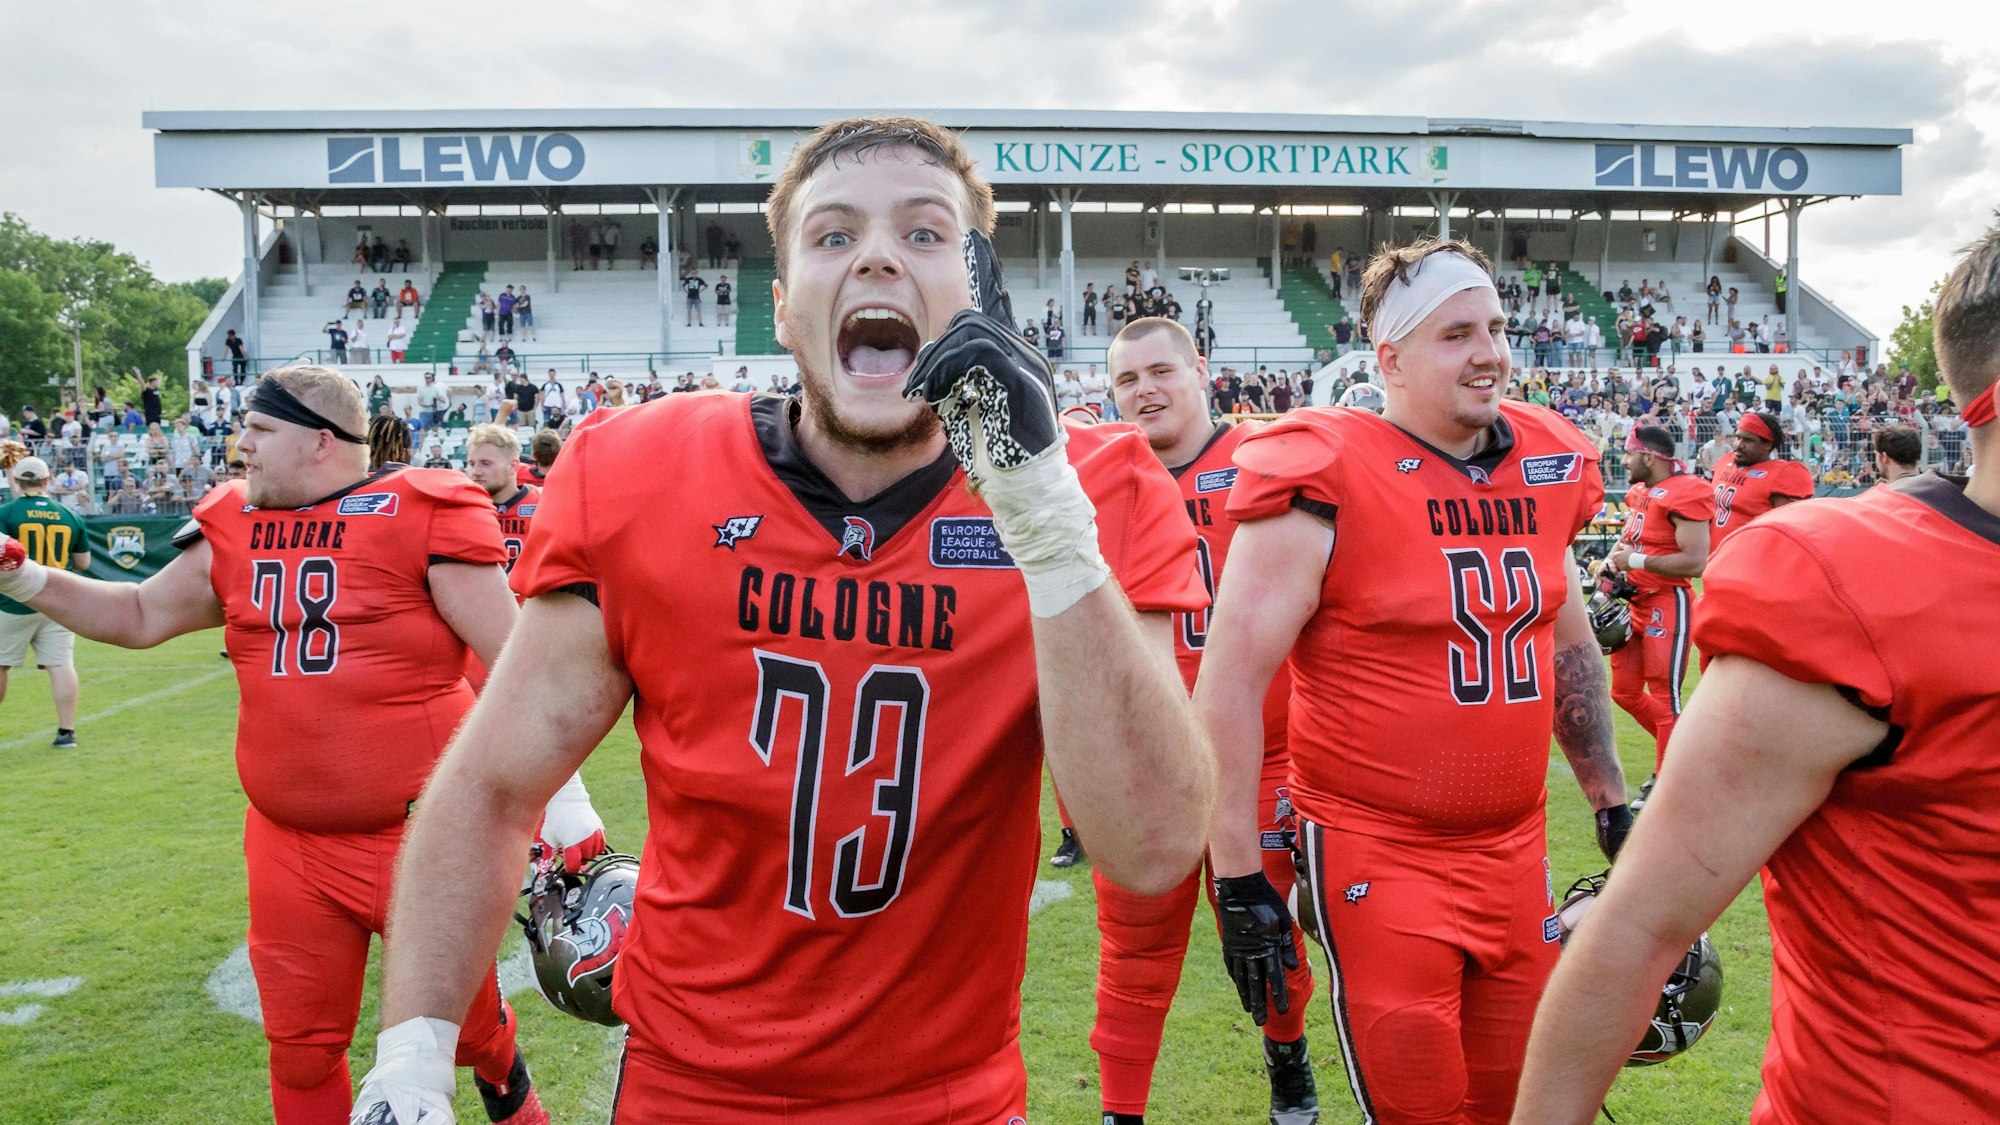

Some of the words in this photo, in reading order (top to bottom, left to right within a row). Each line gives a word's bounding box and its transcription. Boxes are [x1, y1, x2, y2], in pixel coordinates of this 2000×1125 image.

[381, 132, 586, 182] LEWO
[993, 142, 1141, 173] KUNZE
[1180, 143, 1412, 175] SPORTPARK
[1640, 145, 1809, 191] LEWO
[500, 218, 548, 231] verbote
[1742, 380, 1756, 393] 12
[27, 510, 61, 521] KINGS
[941, 525, 998, 536] EUROPEA
[1427, 497, 1538, 536] COLOGNE
[18, 522, 72, 569] 00
[250, 521, 347, 550] COLOGNE
[941, 537, 985, 548] LEAGUE
[985, 541, 997, 549] OF
[940, 548, 1000, 560] FOOTBALL
[251, 556, 341, 677] 78
[737, 564, 957, 652] COLOGNE
[1440, 547, 1543, 706] 52
[748, 648, 931, 921] 73
